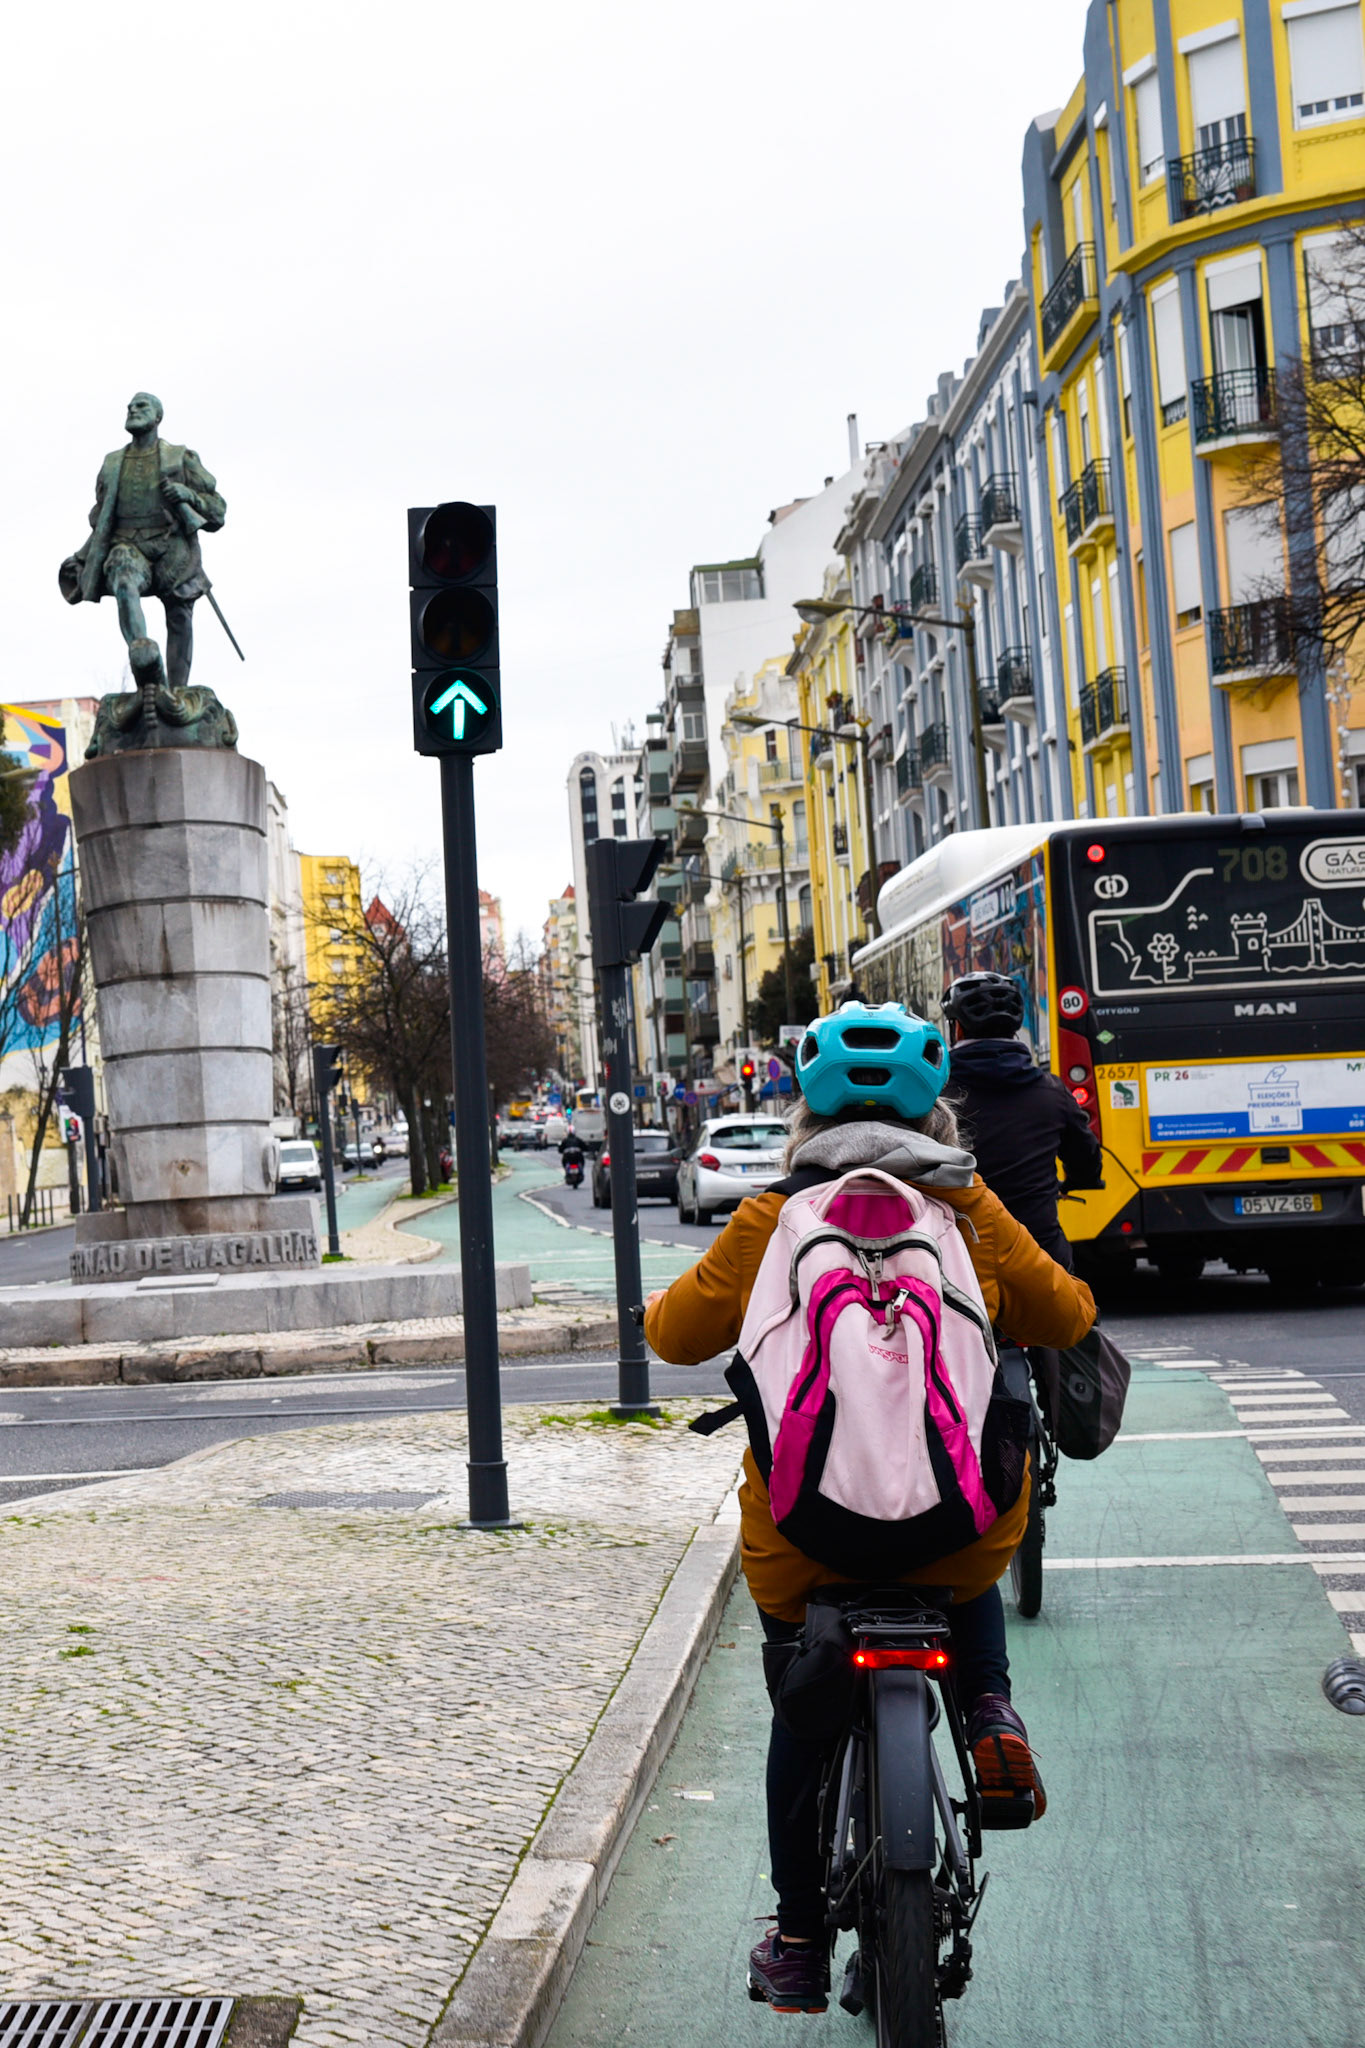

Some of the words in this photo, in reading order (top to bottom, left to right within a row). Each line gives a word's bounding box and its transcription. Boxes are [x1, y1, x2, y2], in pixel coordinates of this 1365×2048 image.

[1217, 846, 1289, 883] 708
[1062, 995, 1081, 1010] 80
[1234, 1002, 1297, 1017] MAN
[1097, 1065, 1135, 1081] 2657
[1154, 1071, 1170, 1082] PR
[1174, 1070, 1189, 1081] 26
[1256, 1091, 1291, 1100] ELEIÇÕES
[134, 1241, 172, 1273] DE
[183, 1231, 319, 1270] MAGALHÃES
